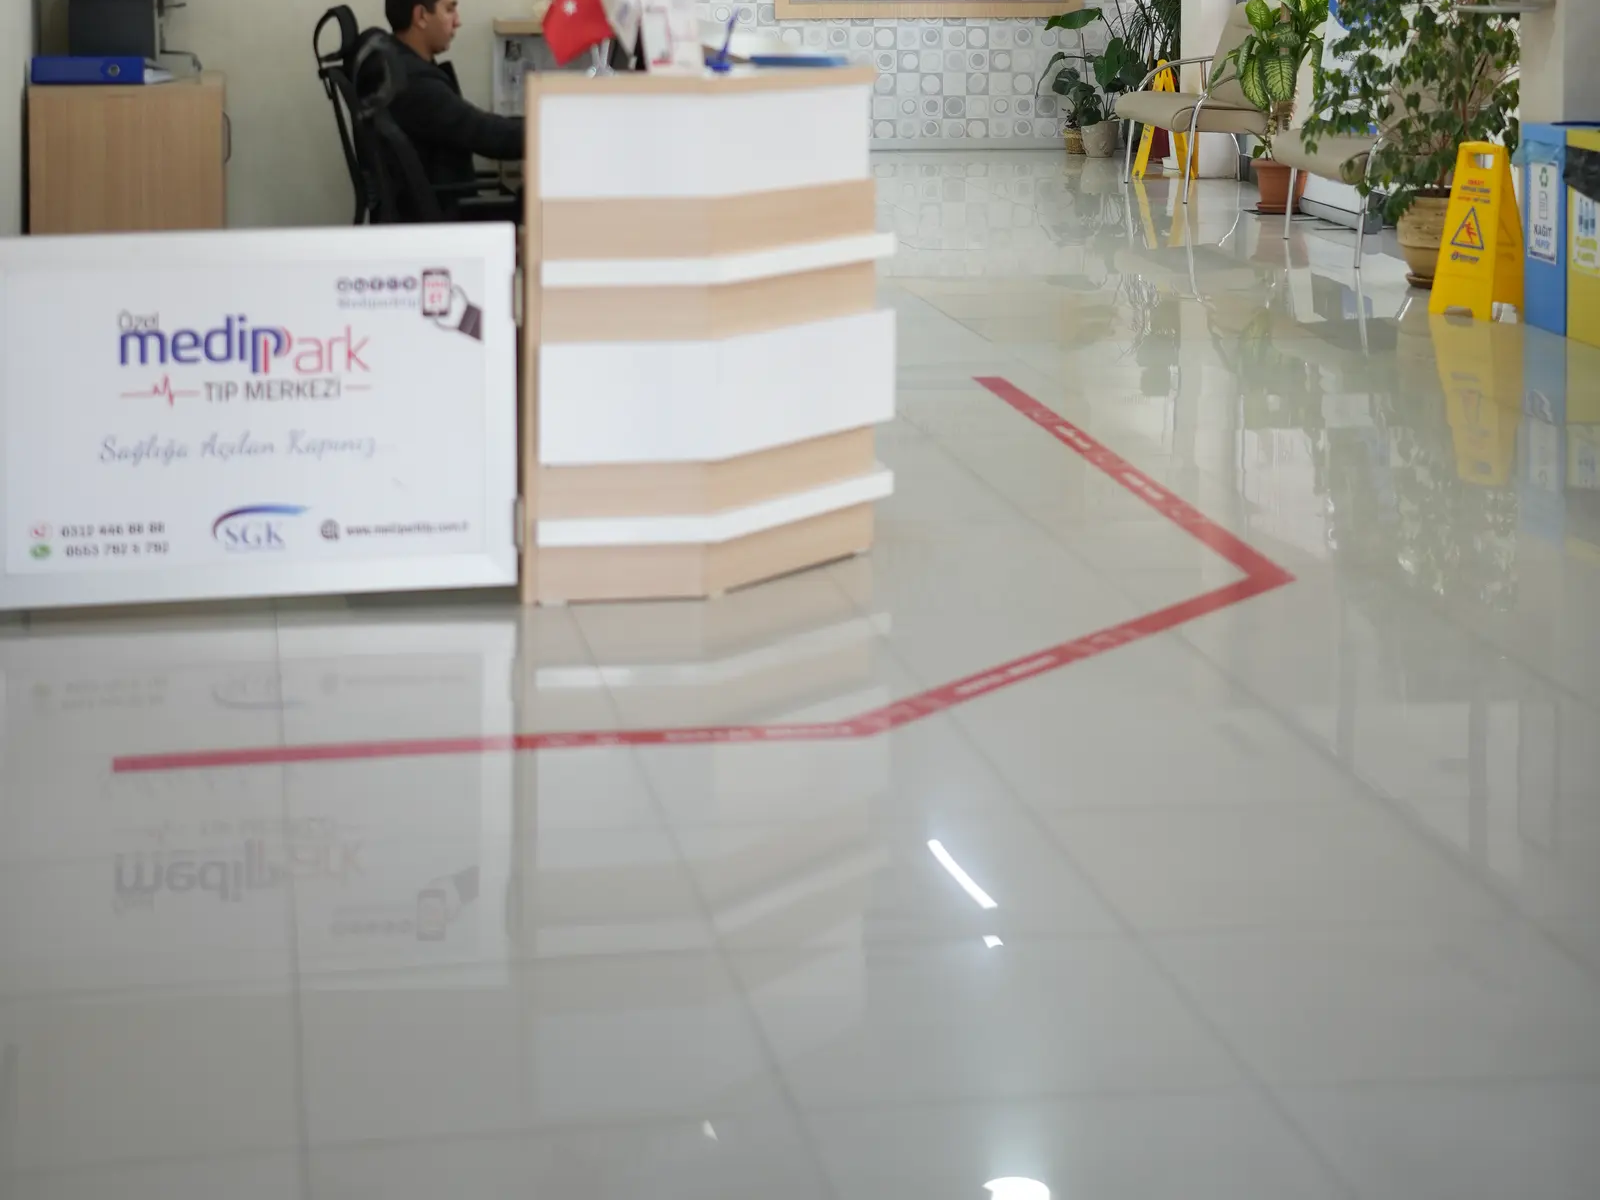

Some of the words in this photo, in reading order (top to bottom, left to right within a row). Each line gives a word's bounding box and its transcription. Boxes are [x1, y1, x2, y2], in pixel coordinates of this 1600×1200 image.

[117, 310, 161, 331] Özel
[245, 377, 342, 400] MERKEZİ
[224, 513, 285, 546] SGK
